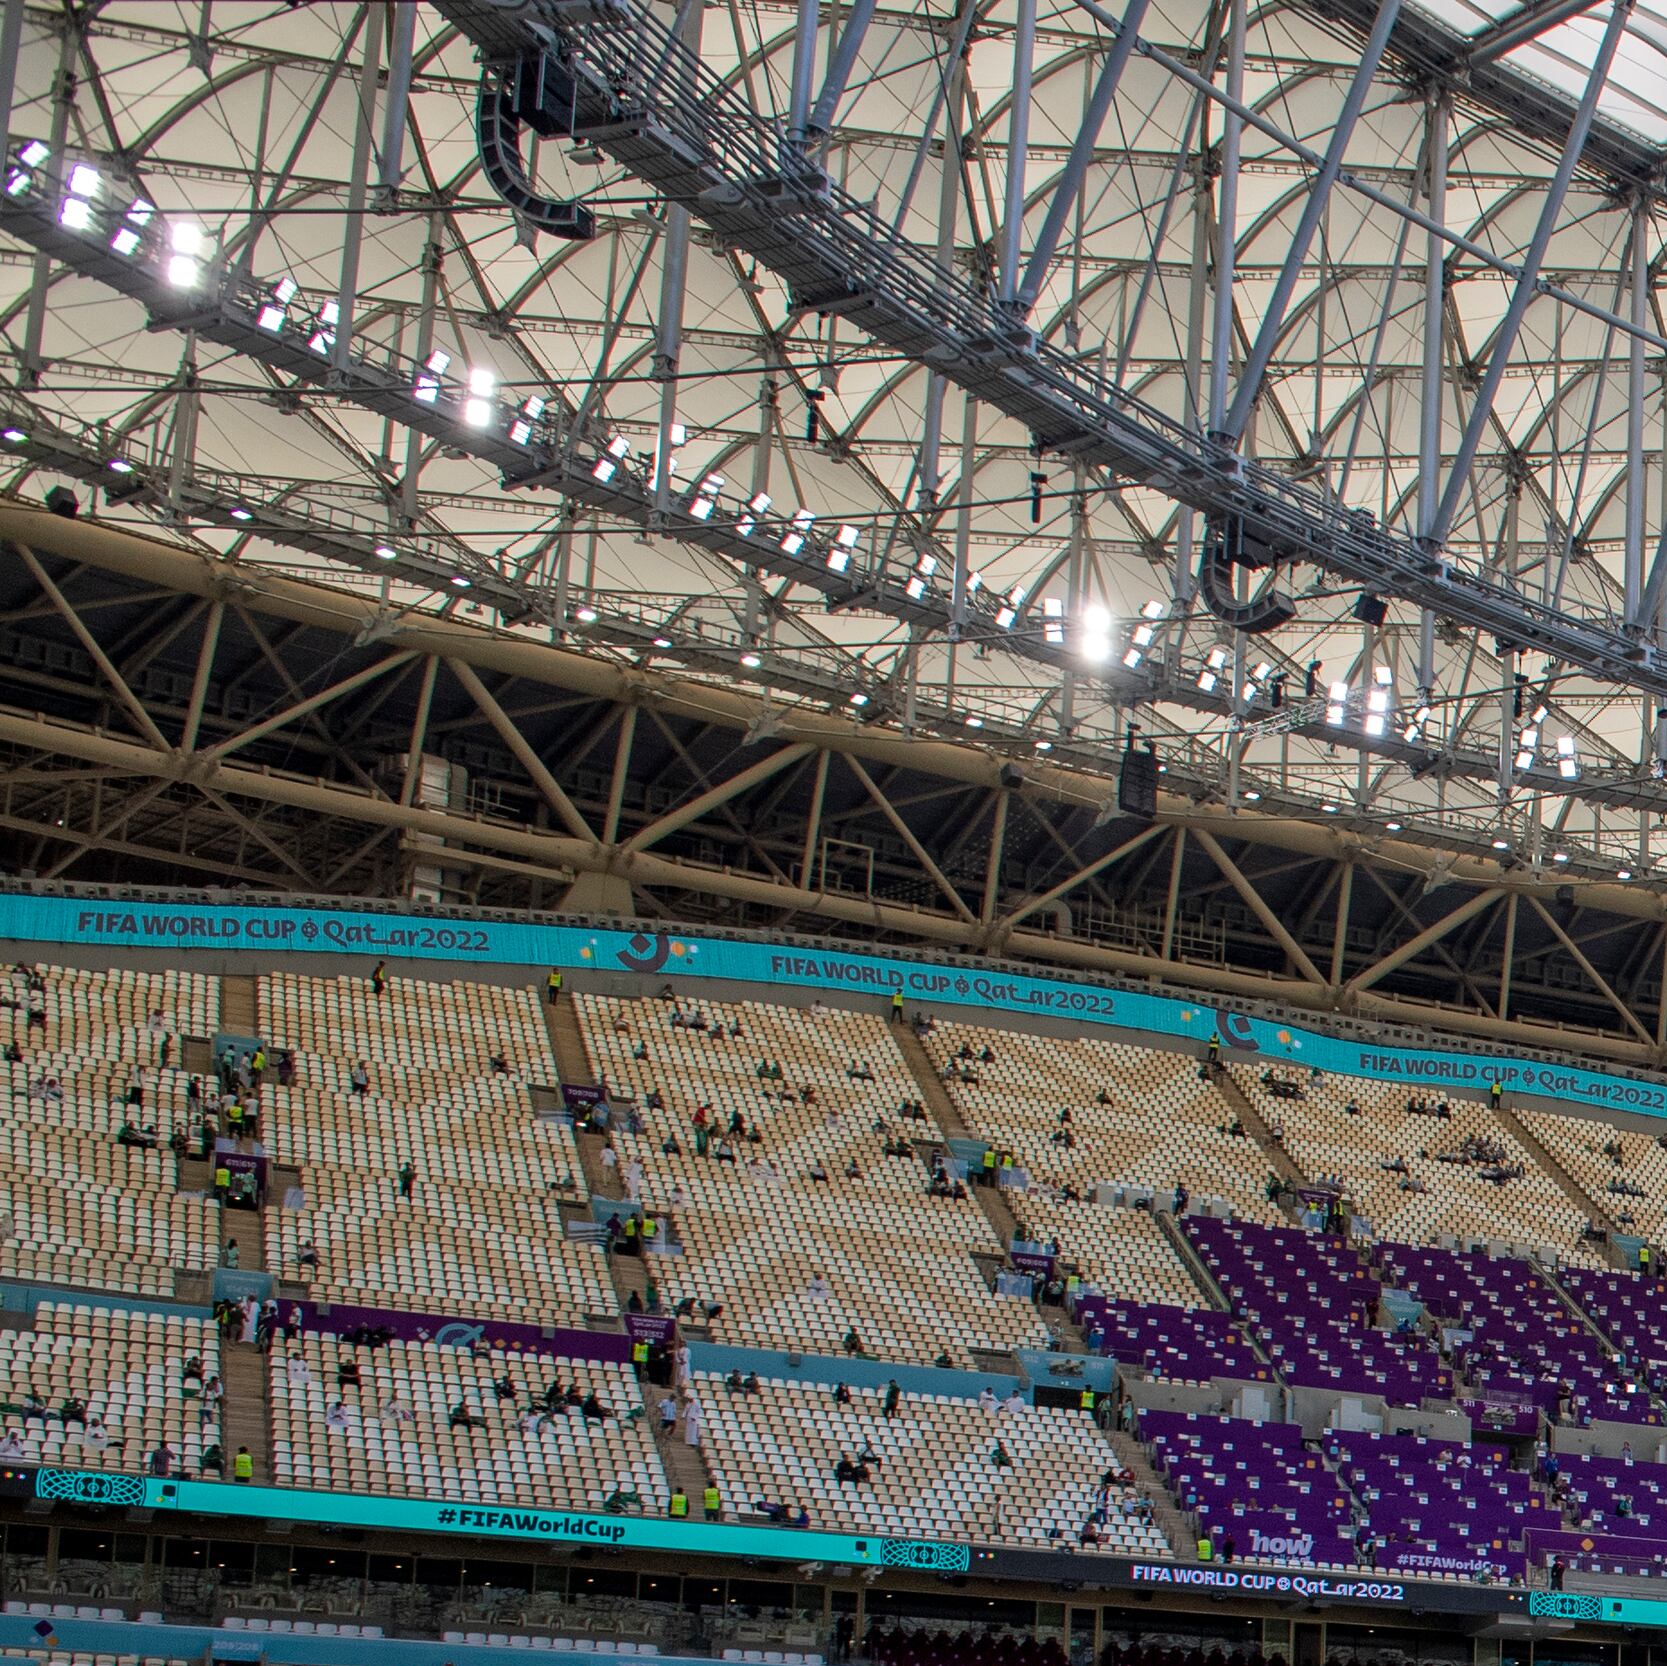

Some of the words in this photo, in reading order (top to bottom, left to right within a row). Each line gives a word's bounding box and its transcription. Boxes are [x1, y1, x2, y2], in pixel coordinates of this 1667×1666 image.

[77, 911, 138, 934] FIFA
[142, 914, 240, 938] WORLD
[245, 918, 296, 939] CUP
[771, 956, 819, 977] FIFA
[820, 960, 905, 987] WORLD
[909, 971, 951, 992] CUP
[1360, 1055, 1402, 1075] FIFA
[1404, 1058, 1478, 1080] WORLD
[1480, 1065, 1519, 1084] CUP
[437, 1508, 625, 1541] #FIFAWorldCup
[1251, 1534, 1313, 1556] now
[1132, 1564, 1172, 1583] FIFA
[1173, 1568, 1240, 1588] WORLD
[1241, 1574, 1276, 1591] CUP
